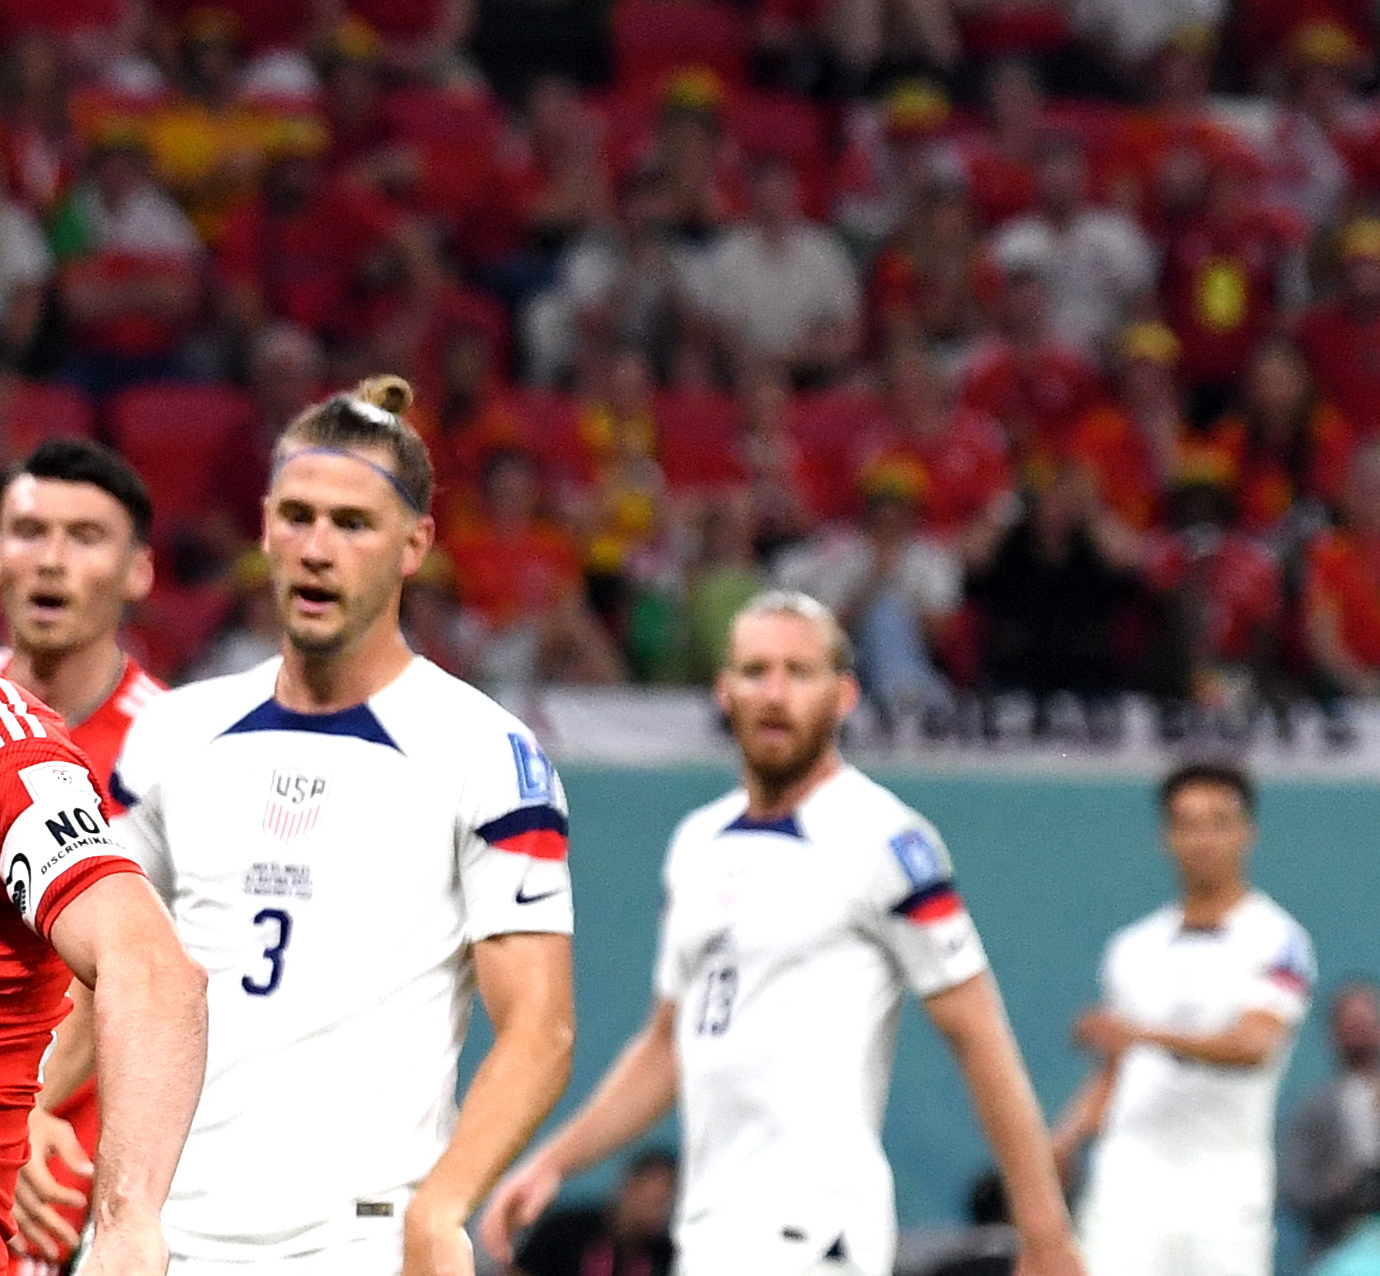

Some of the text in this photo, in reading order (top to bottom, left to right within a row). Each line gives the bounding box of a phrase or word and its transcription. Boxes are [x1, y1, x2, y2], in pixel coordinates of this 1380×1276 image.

[276, 775, 327, 804] USA
[44, 807, 100, 847] NO
[241, 907, 293, 998] 3
